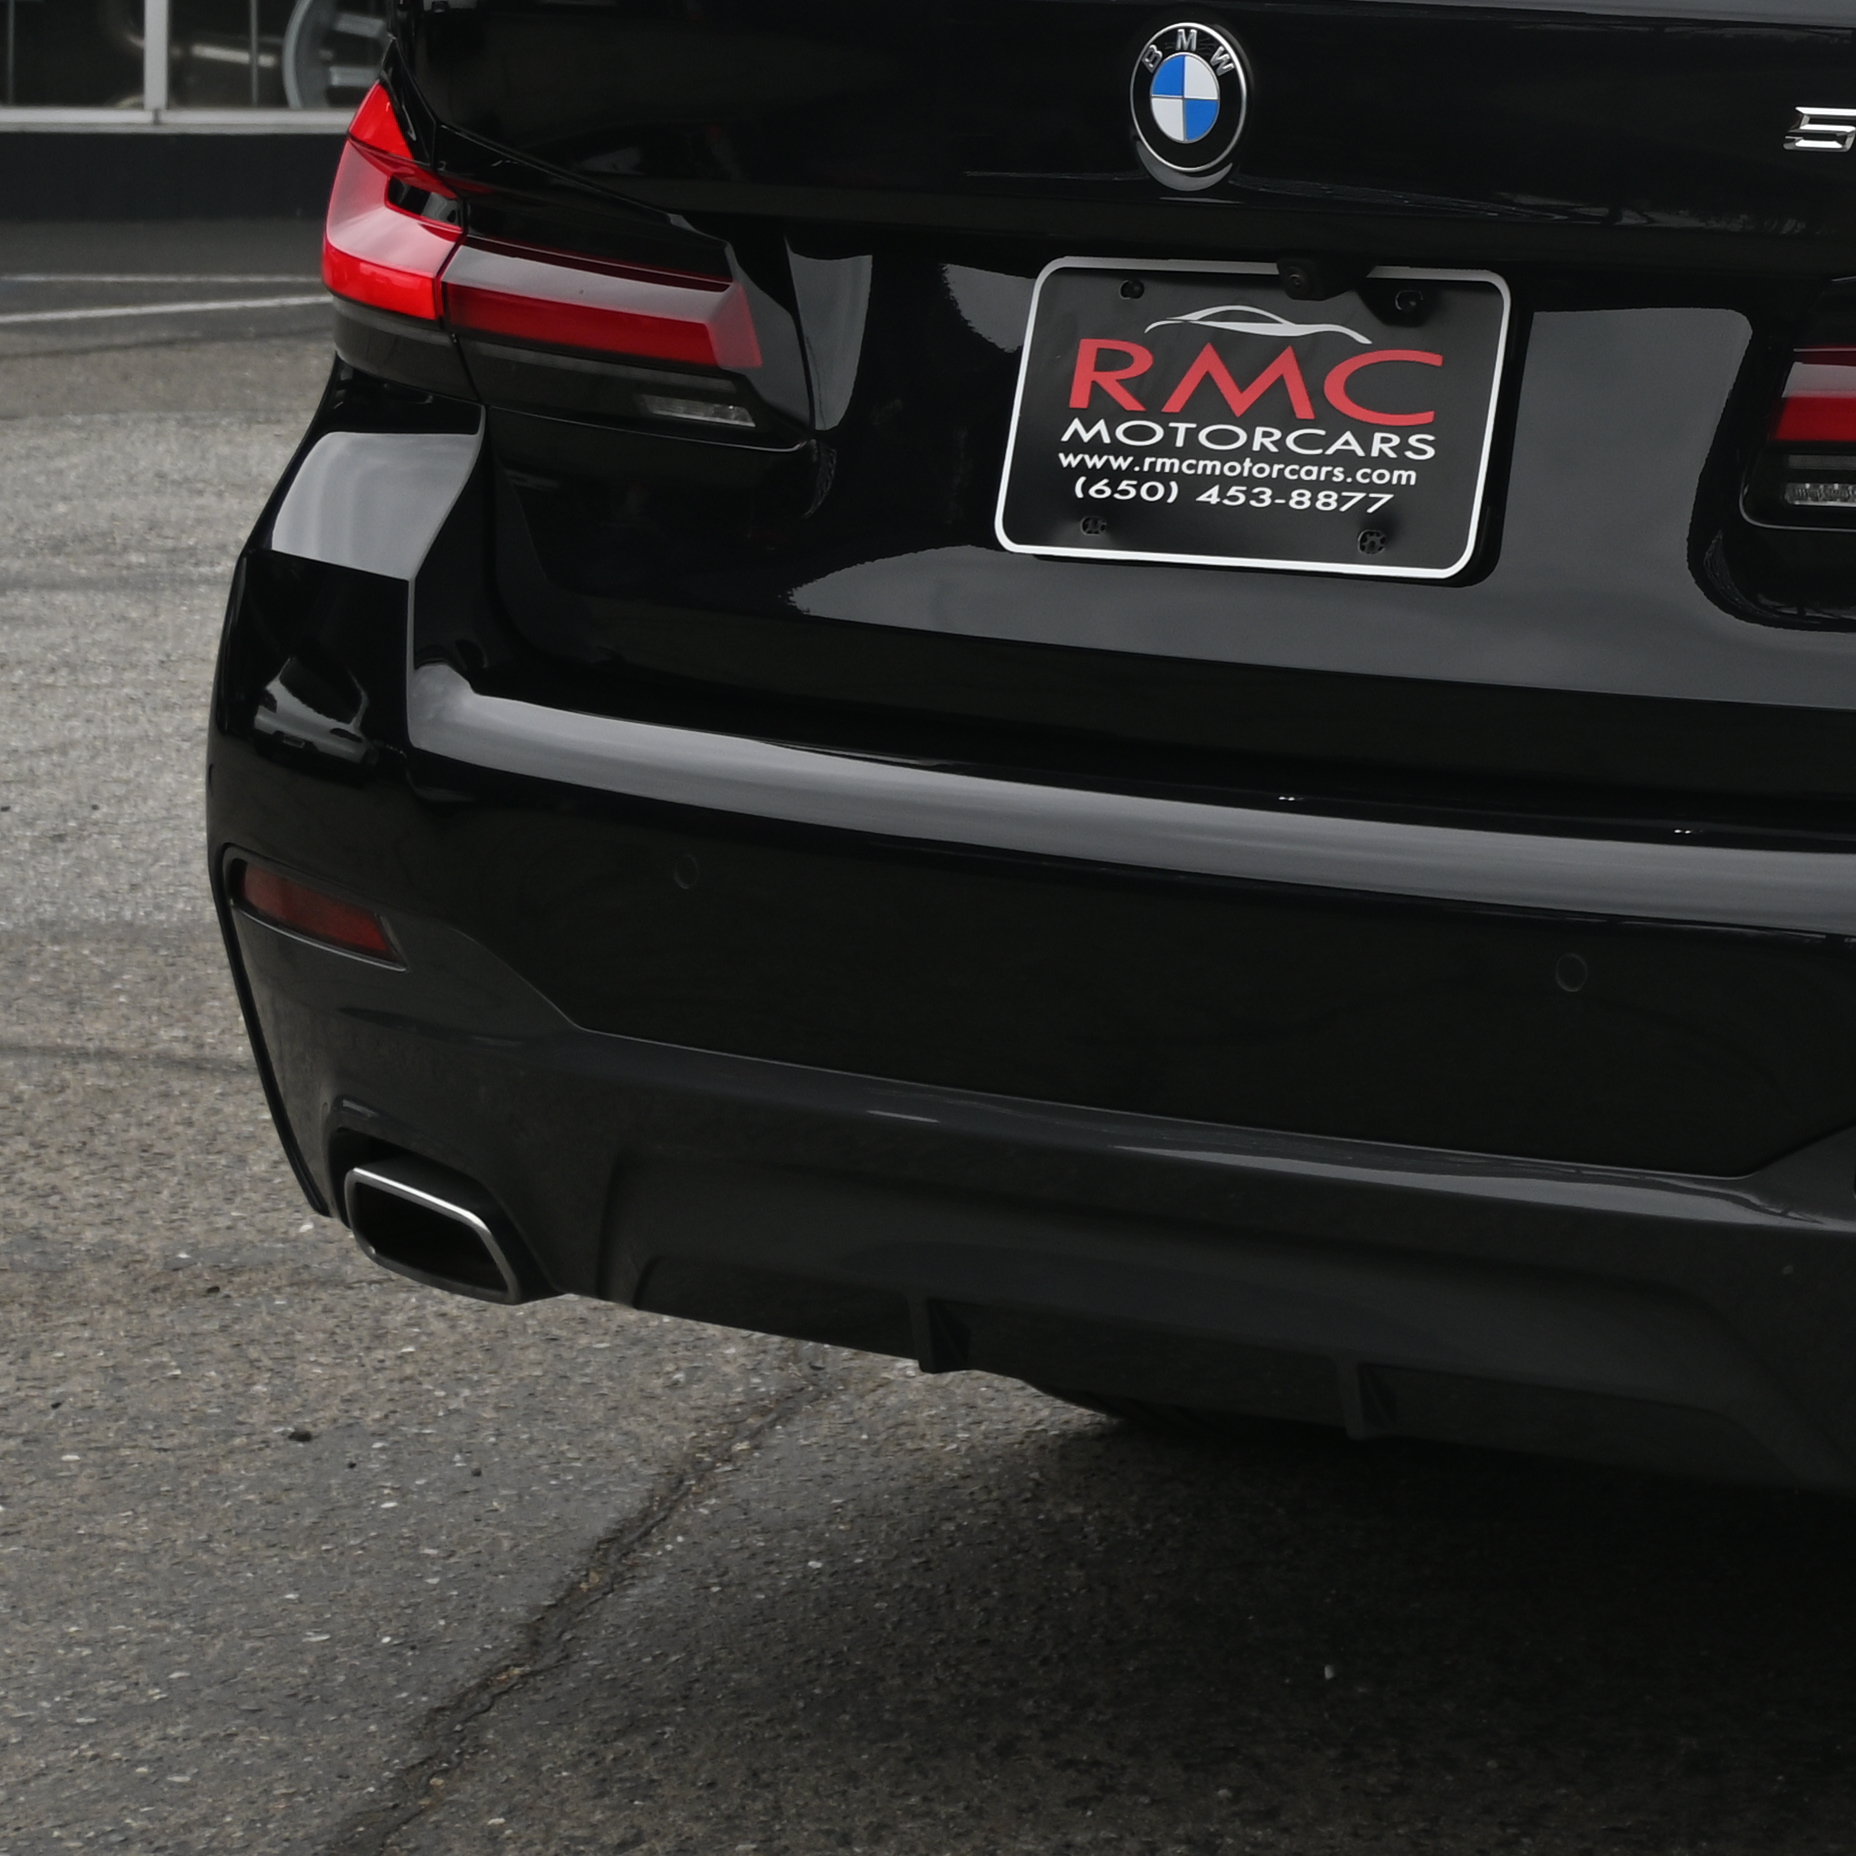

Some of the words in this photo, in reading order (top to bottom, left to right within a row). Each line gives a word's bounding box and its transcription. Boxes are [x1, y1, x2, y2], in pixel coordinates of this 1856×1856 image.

[1141, 29, 1234, 76] BMW
[1069, 338, 1444, 426] RMC
[1060, 418, 1436, 460] MOTORCARS
[1058, 453, 1417, 486] www.rmcmotorcars.com
[1075, 476, 1179, 504] (650)
[1196, 485, 1394, 513] 453-8877
